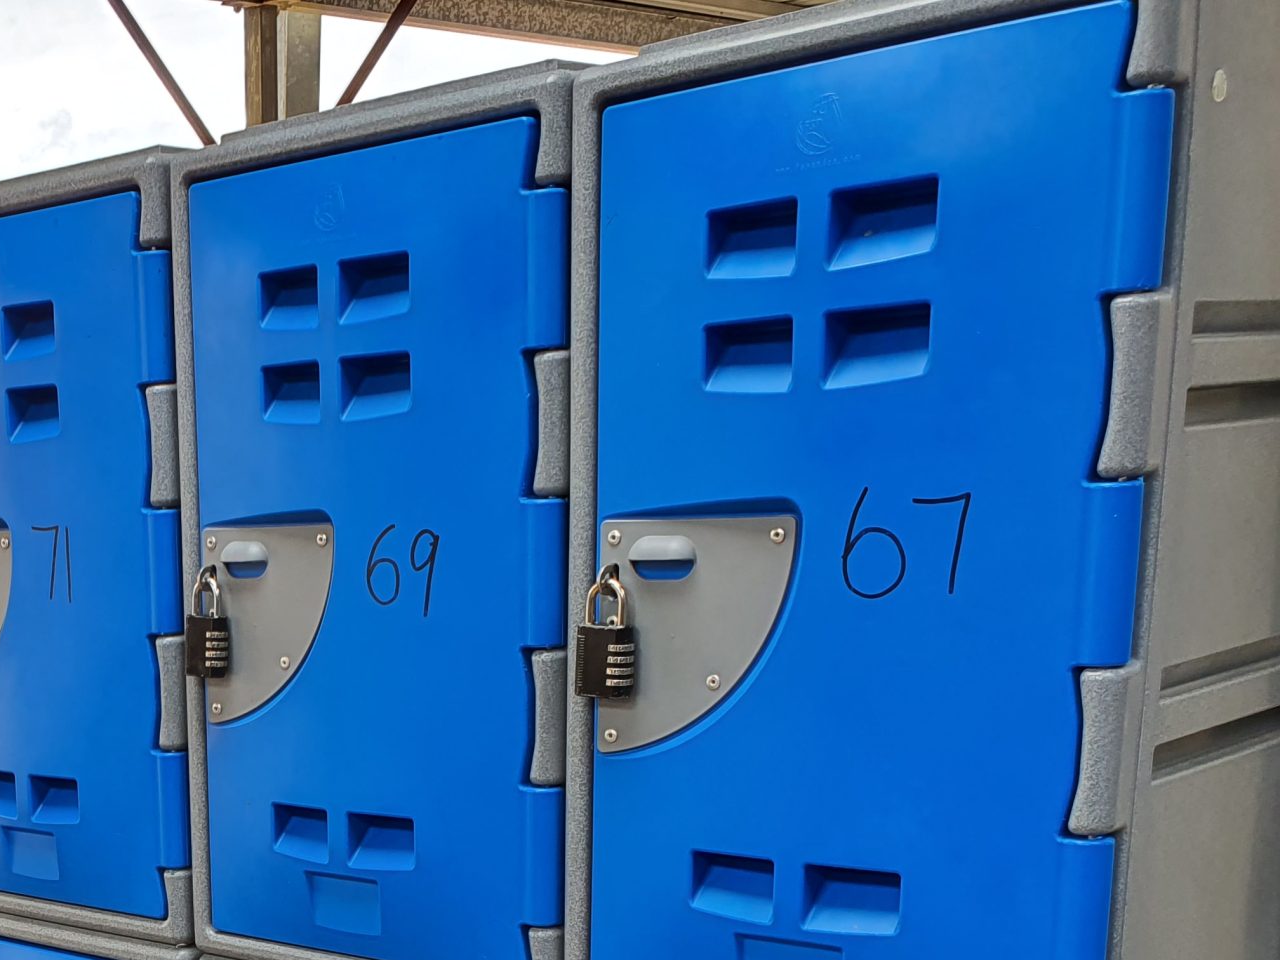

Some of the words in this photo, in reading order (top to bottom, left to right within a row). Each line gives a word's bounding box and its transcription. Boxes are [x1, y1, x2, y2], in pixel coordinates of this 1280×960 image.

[31, 525, 72, 605] 71
[366, 523, 440, 618] 69
[841, 486, 972, 601] 67
